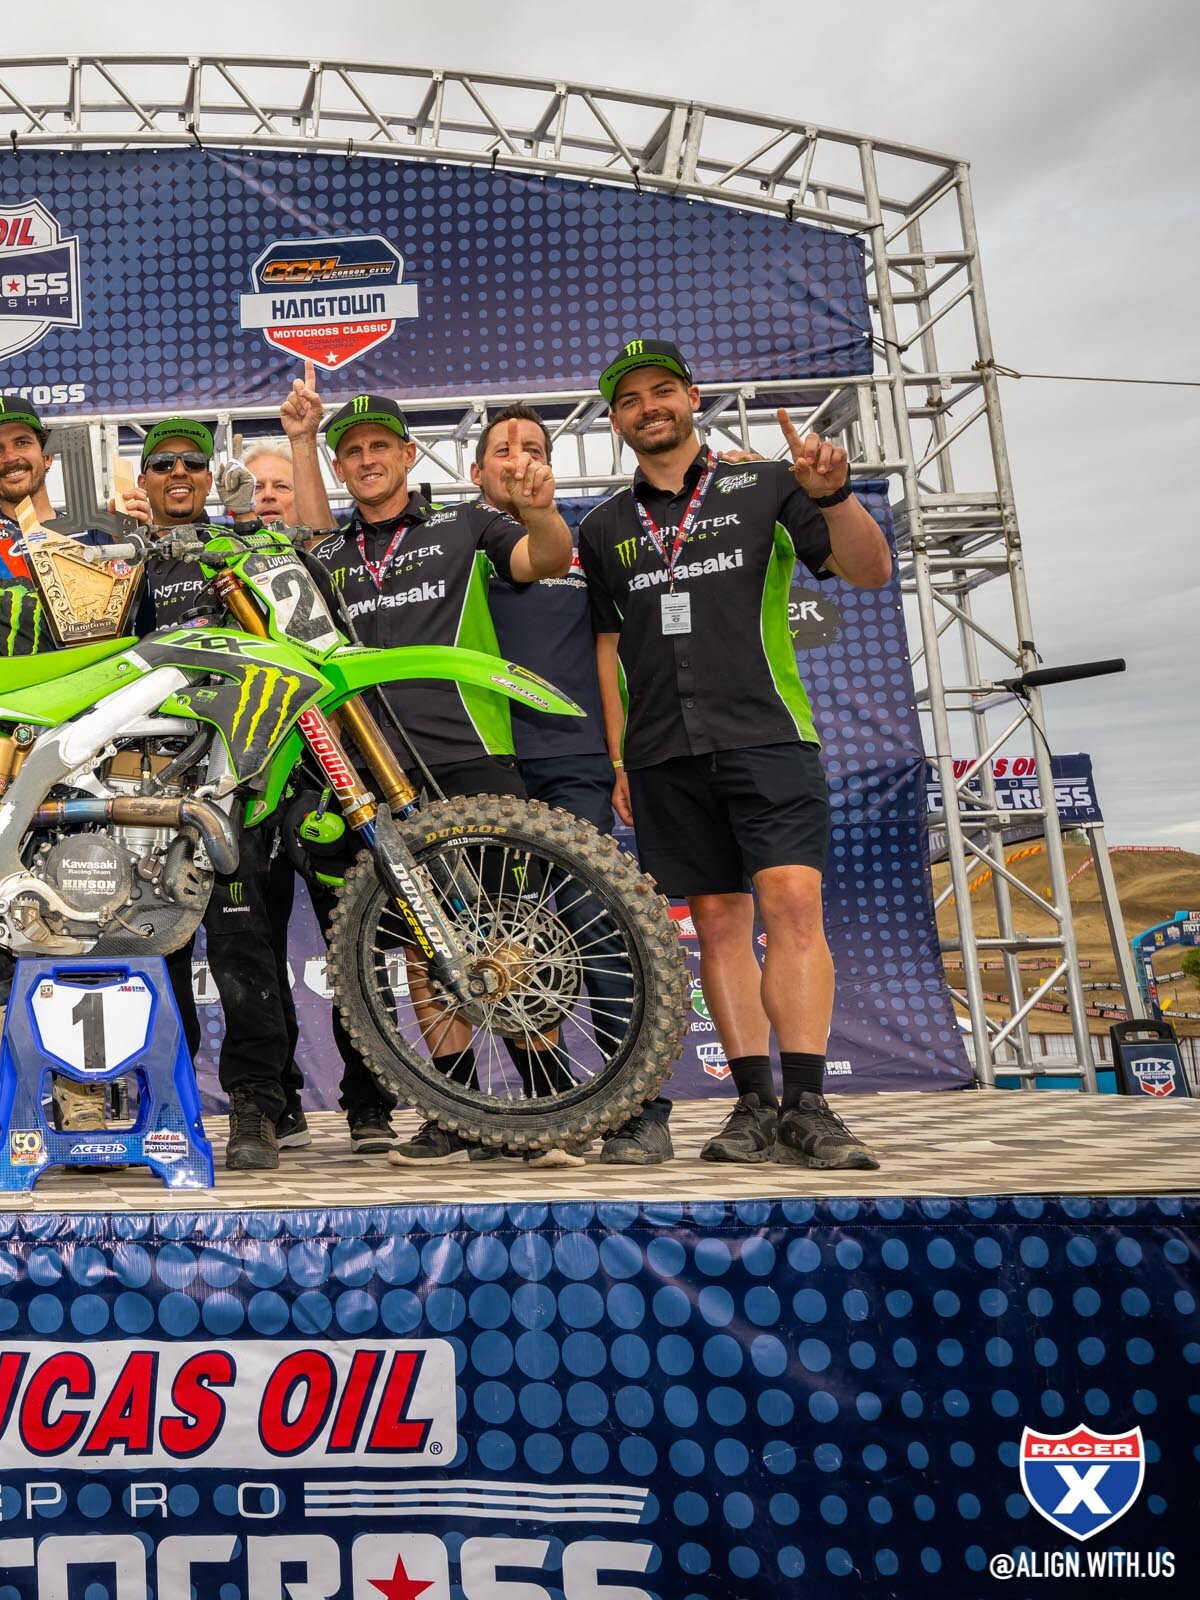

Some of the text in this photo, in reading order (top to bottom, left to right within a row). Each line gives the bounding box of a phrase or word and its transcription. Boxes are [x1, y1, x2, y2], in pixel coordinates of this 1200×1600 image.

[272, 293, 385, 320] HANGTOWN
[273, 324, 387, 339] MOTOCROSS CLASSIC
[606, 357, 668, 382] Kawasaki
[153, 426, 206, 440] Kawasaki
[333, 416, 391, 433] Kawasaki
[154, 580, 204, 600] NSTER
[68, 620, 112, 633] Hangtown
[286, 637, 320, 658] Kawasaki
[298, 709, 356, 791] SHOWA
[1012, 757, 1037, 776] OI
[425, 825, 508, 844] DUNLOP
[62, 858, 117, 870] Kawasaki
[68, 869, 91, 877] Racing
[62, 879, 116, 890] HINSON
[389, 863, 453, 959] DUNLOP
[396, 897, 434, 959] ACERBIS
[72, 992, 106, 1069] 1
[826, 1060, 851, 1070] PRO
[827, 1068, 853, 1076] RACING
[15, 1132, 40, 1153] 50
[70, 1144, 127, 1154] ACERBIS
[257, 1350, 434, 1456] OIL
[26, 1483, 280, 1520] PRO
